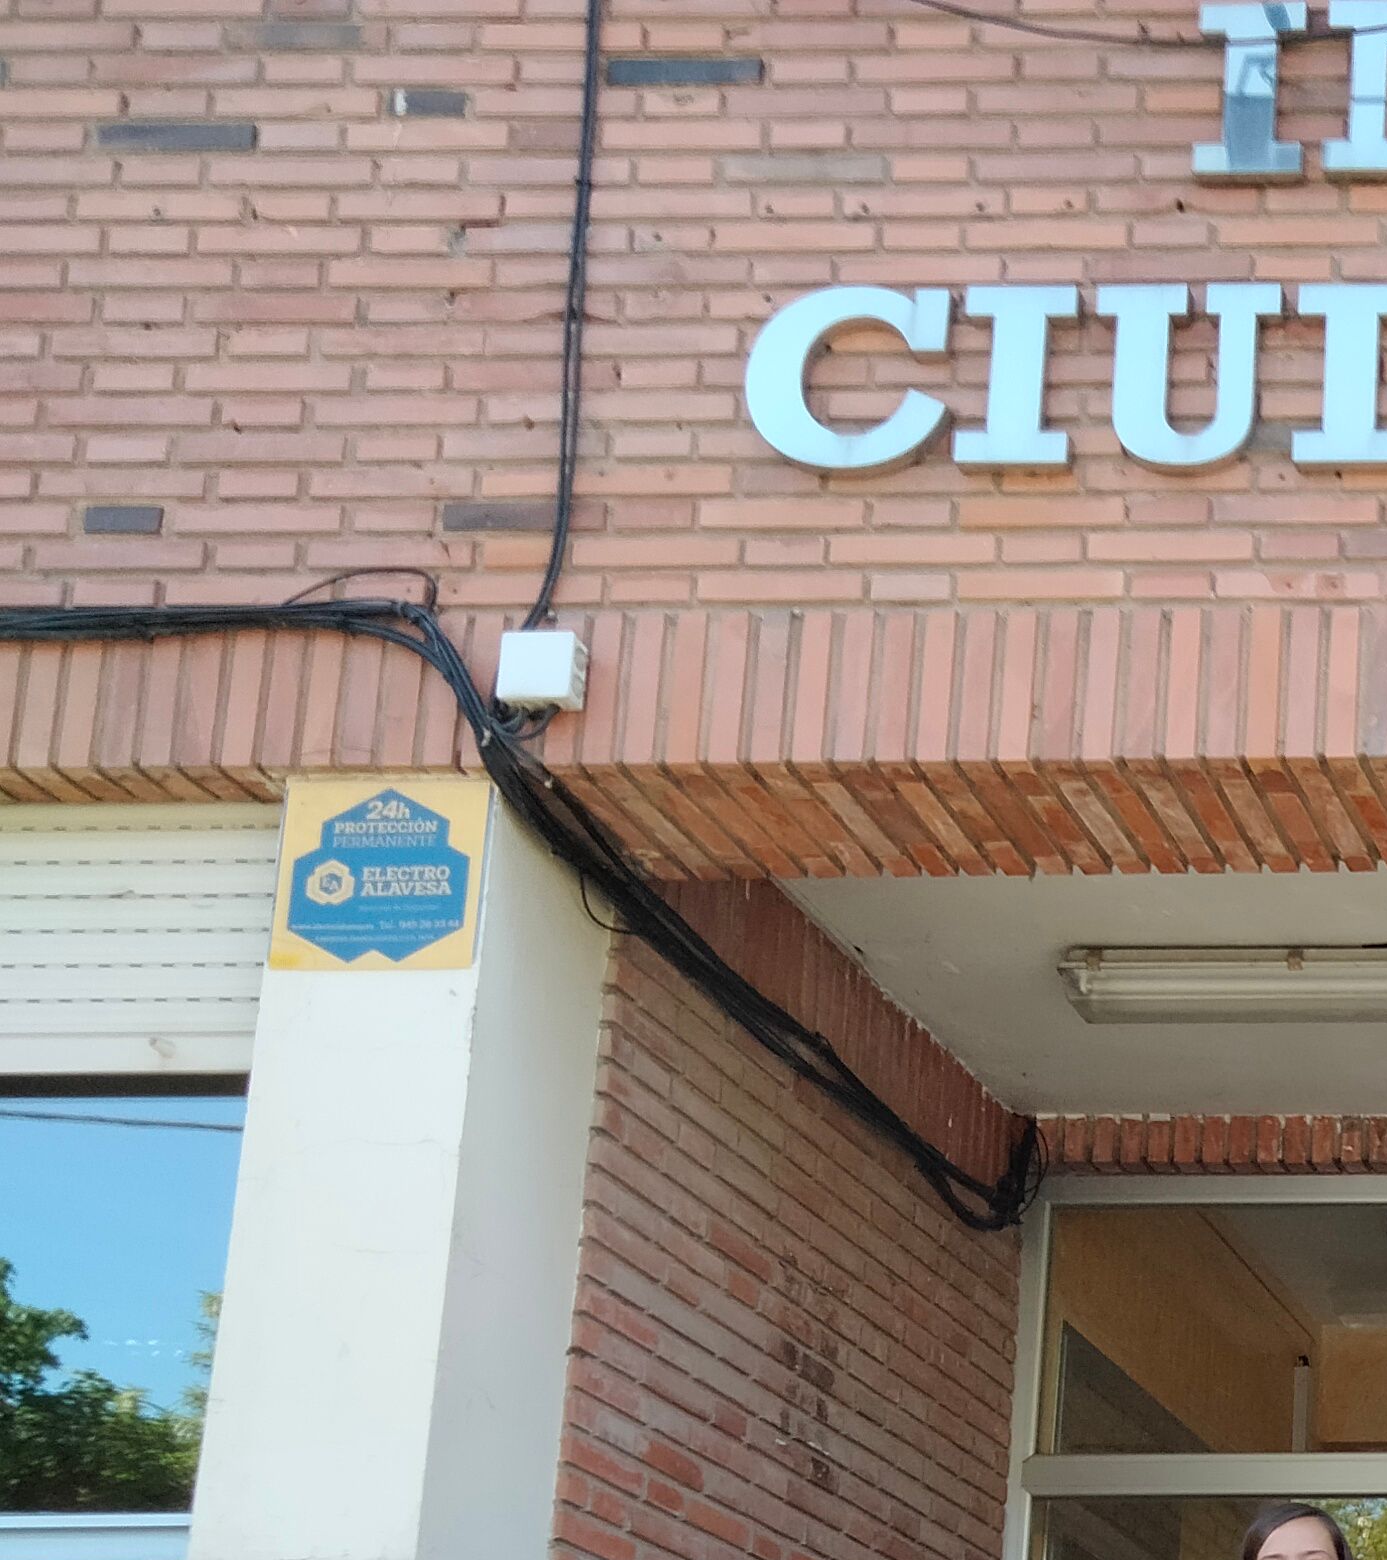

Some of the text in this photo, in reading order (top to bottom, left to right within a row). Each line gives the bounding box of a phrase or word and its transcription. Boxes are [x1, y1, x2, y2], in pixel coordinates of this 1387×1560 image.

[366, 800, 411, 820] 24h
[333, 818, 438, 834] PROTECCIÓN
[332, 834, 436, 848] PERMANENTE
[361, 866, 450, 882] ELECTRO
[360, 880, 452, 897] ALAVESA
